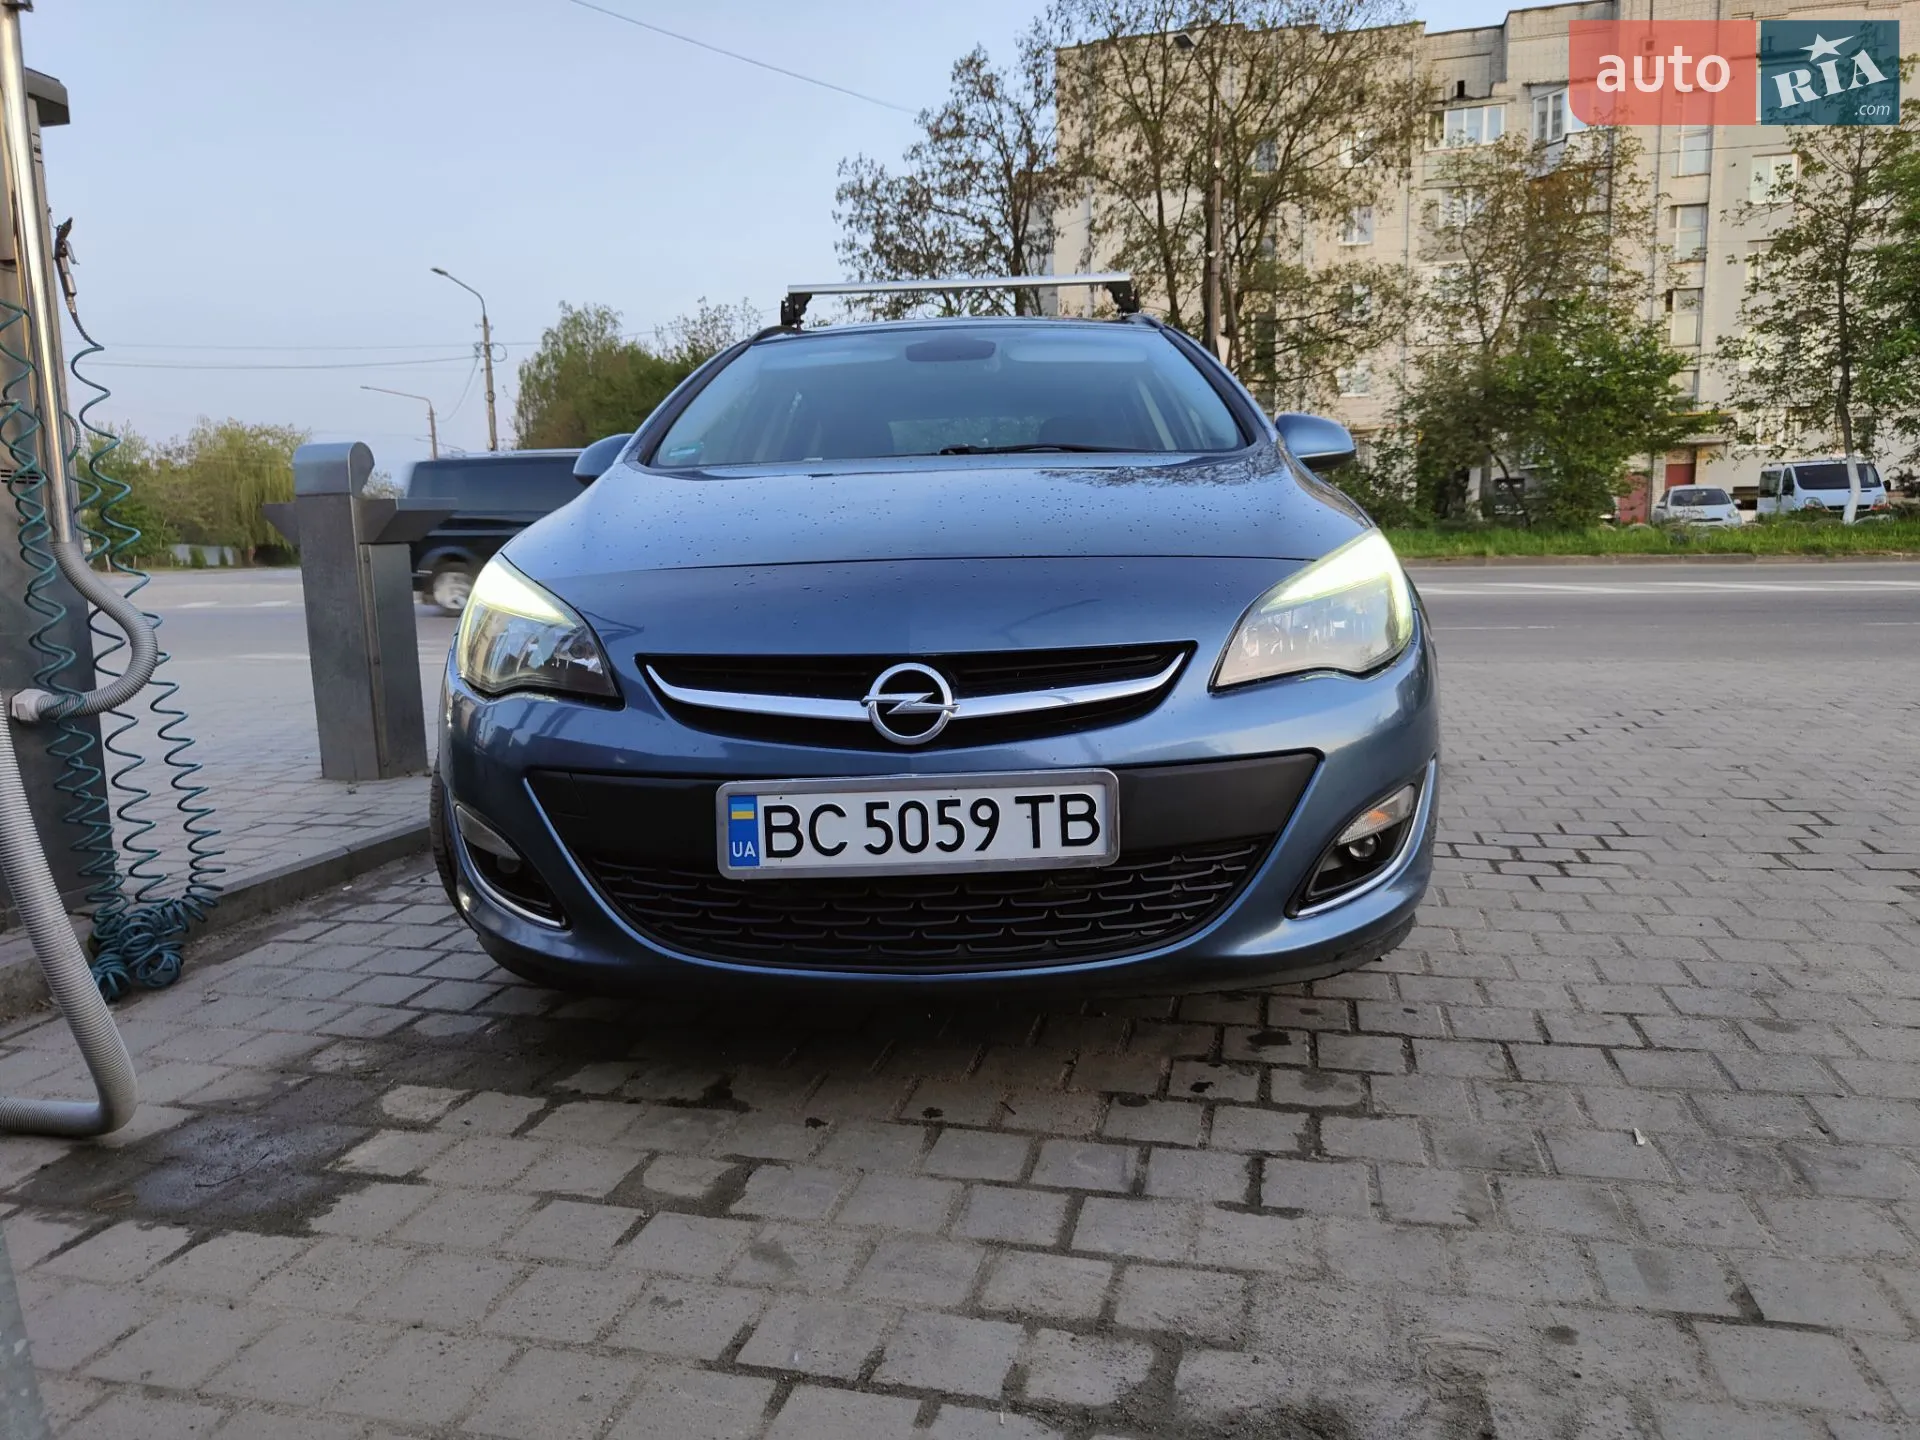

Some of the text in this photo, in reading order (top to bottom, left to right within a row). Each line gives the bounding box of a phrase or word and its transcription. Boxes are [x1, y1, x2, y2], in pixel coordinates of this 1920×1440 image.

[763, 793, 1101, 858] BC 5059 TB
[731, 840, 756, 858] UA
